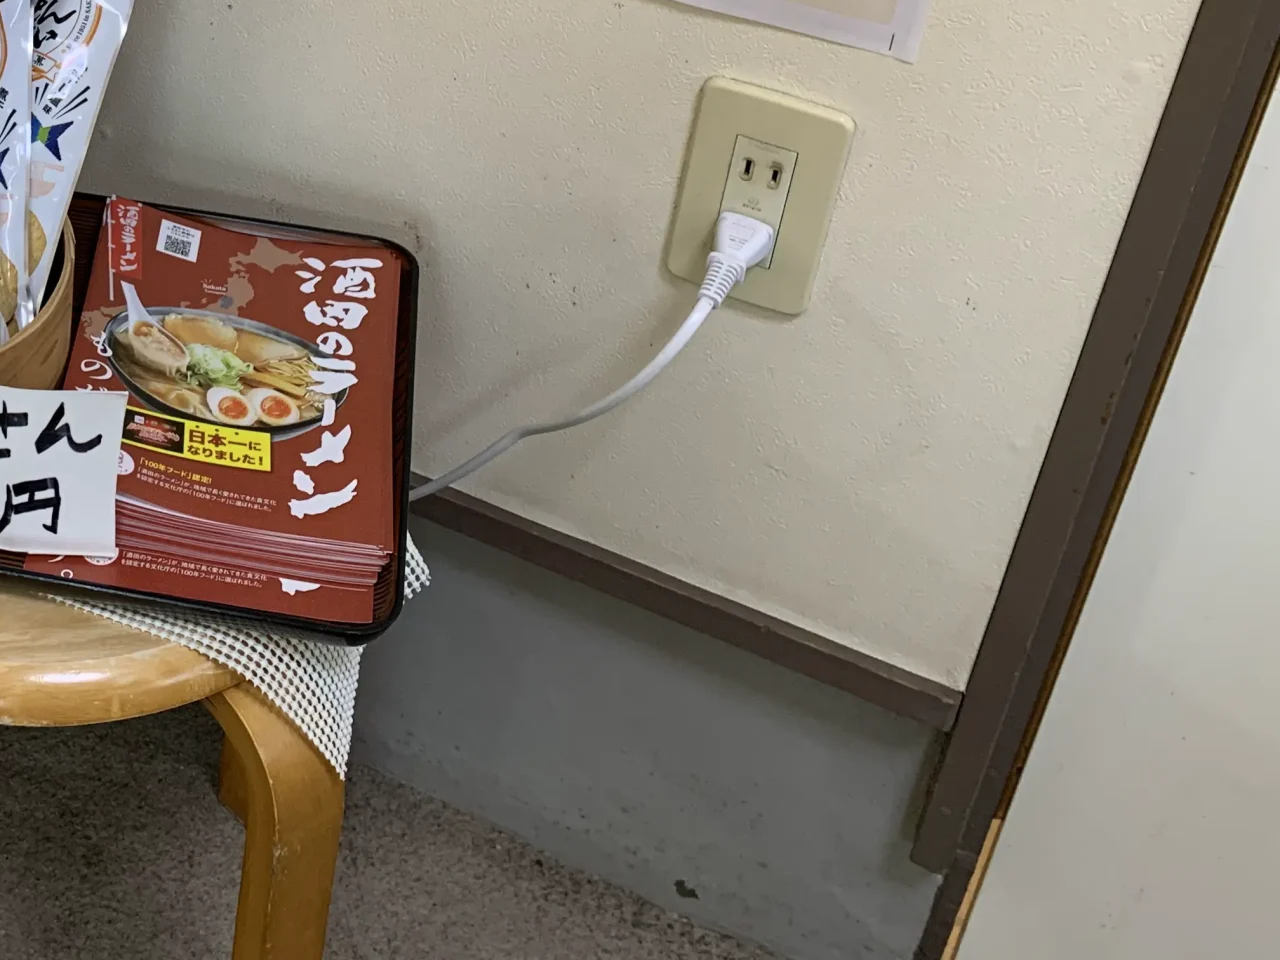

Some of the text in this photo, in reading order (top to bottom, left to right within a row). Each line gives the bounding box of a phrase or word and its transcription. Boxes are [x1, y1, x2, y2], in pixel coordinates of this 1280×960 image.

[117, 204, 140, 272] 酒田のラーメン
[287, 256, 384, 520] 酒田のラーメン
[188, 428, 262, 452] 日本一に
[186, 444, 265, 466] なりました!
[139, 456, 213, 484] 「100年フード」認定!
